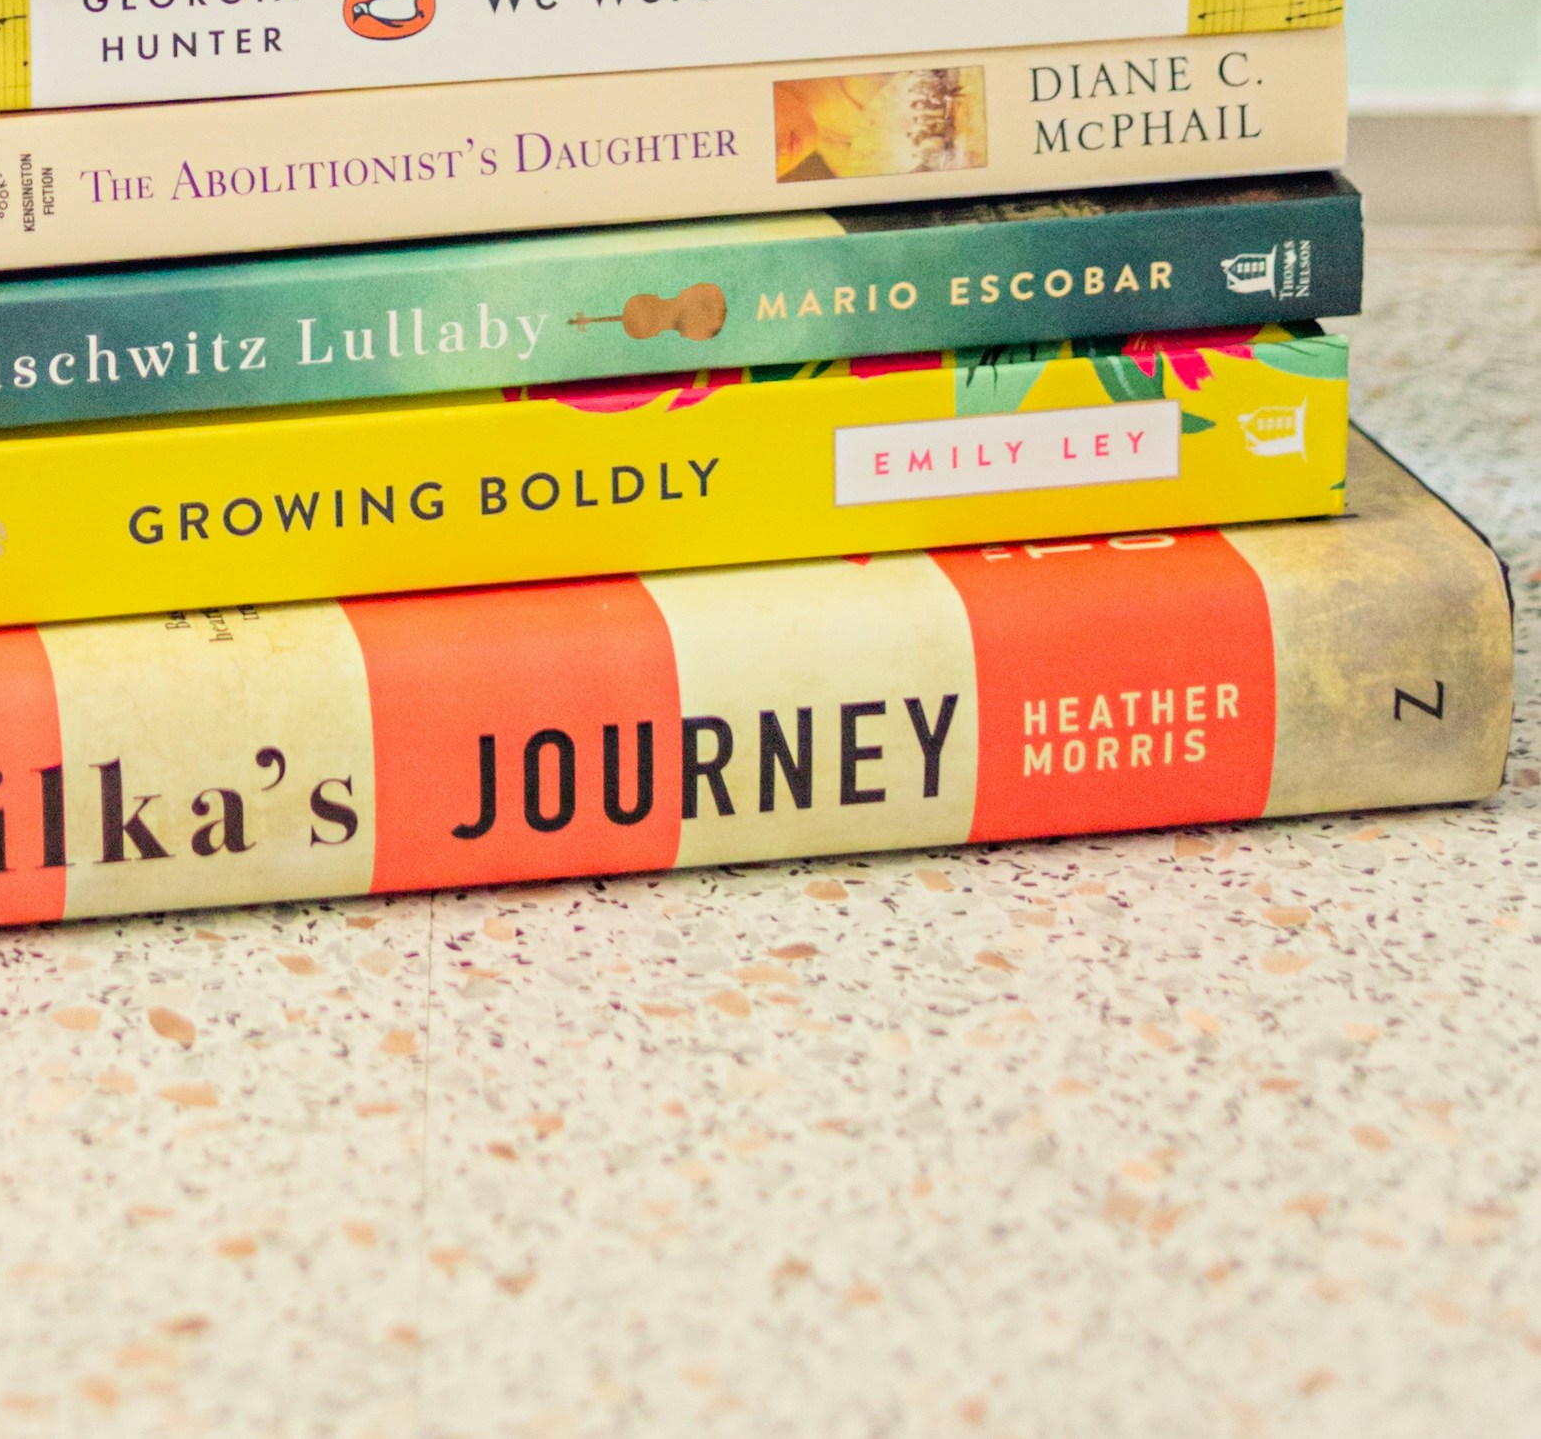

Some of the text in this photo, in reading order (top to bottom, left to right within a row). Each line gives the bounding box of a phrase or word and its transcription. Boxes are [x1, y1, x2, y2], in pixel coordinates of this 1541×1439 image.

[101, 26, 284, 63] HUNTER
[1030, 51, 1263, 104] DIANE C.
[20, 153, 35, 232] KENSINGTON
[41, 167, 55, 216] FICTION
[80, 168, 153, 204] THE
[515, 130, 739, 174] DAUGHTER
[756, 261, 1177, 320] MARIO ESCOBAR
[298, 303, 548, 366] Lullaby
[873, 431, 1147, 476] EMILY LEY
[128, 457, 721, 546] GROWING BOLDLY
[1024, 683, 1240, 736] HEATHER
[451, 694, 959, 842] JOURNEY
[1024, 730, 1206, 778] MORRIS
